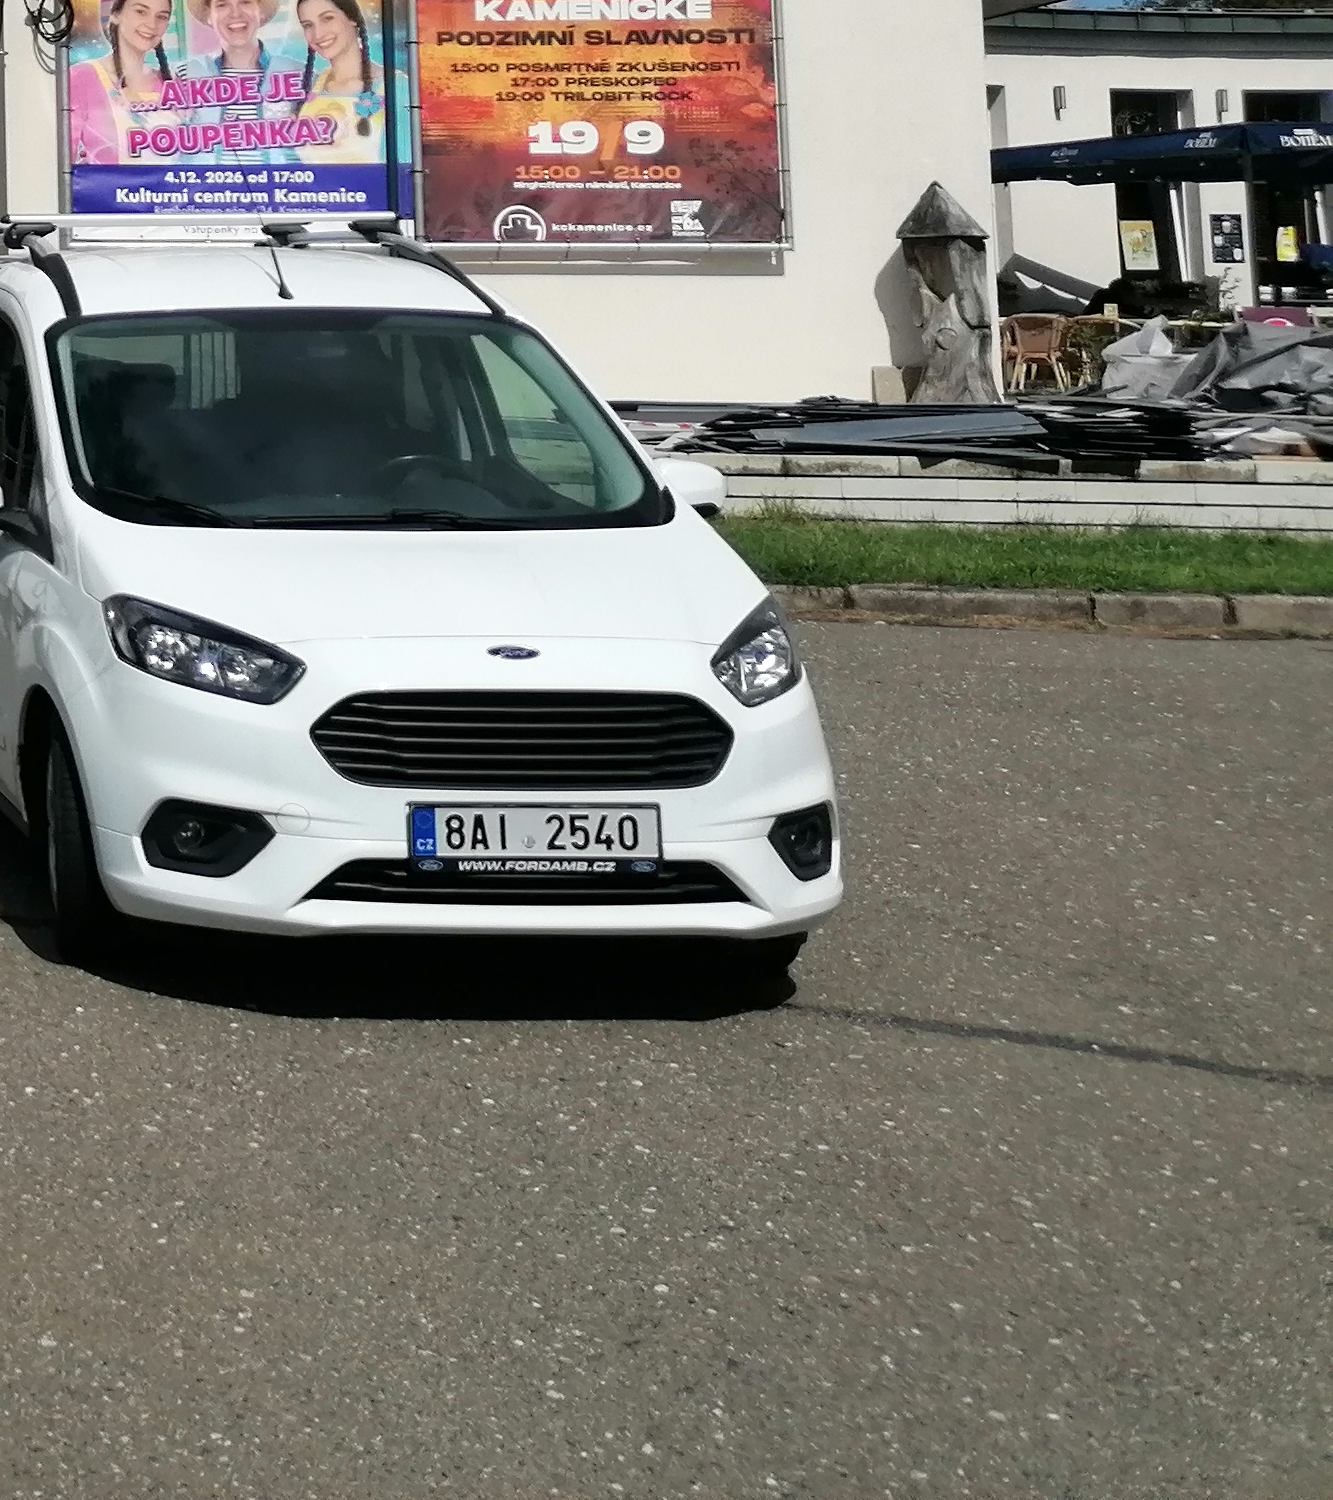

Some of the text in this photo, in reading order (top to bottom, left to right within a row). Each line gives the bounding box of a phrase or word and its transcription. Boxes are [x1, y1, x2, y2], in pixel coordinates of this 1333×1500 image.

[436, 26, 757, 47] PODZIMNÍ SLAVNOSTI
[450, 58, 742, 74] 15:00 POSMRTNÉ ZKUŠENOSTI
[183, 74, 259, 107] KDE
[266, 70, 306, 103] JE
[509, 76, 560, 88] 17:00
[494, 91, 545, 103] 19:00
[640, 90, 695, 103] ROCK
[127, 112, 338, 159] POUPĚNKA?
[163, 169, 316, 185] 4.12. 2026 od 17:00
[514, 164, 581, 180] 15:00
[613, 163, 682, 180] 21:00
[193, 187, 269, 203] centrum
[274, 187, 368, 204] Kamenice
[444, 813, 640, 852] 8AI 2540
[416, 838, 435, 850] CZ
[457, 860, 617, 874] WWW.FORDAMB.CZ
